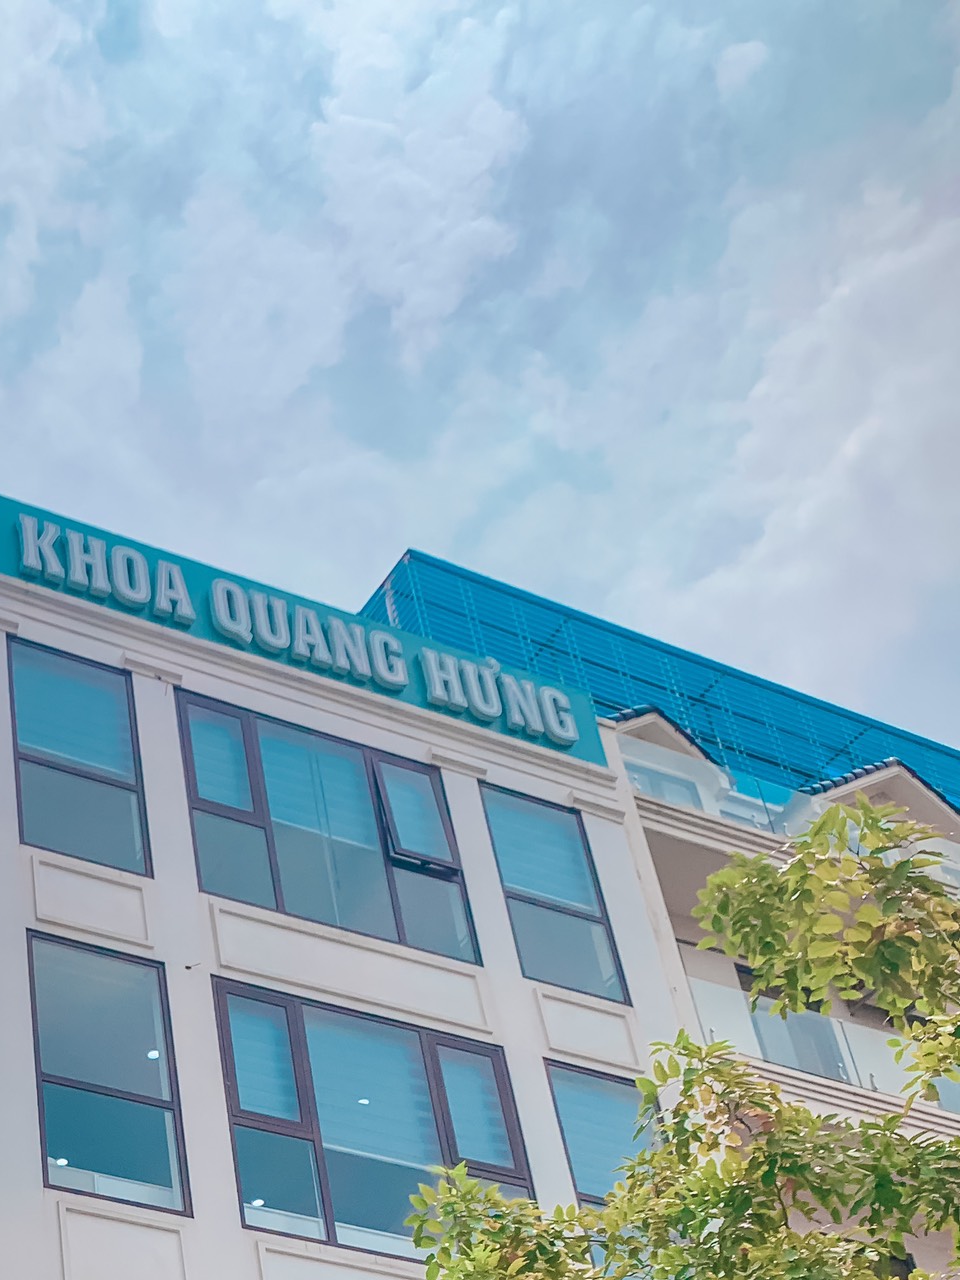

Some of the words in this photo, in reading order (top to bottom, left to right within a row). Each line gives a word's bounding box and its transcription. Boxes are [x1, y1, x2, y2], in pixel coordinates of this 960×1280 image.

[18, 513, 196, 627] KHOA
[210, 577, 407, 690] QUANG
[419, 647, 580, 746] HƯNG
